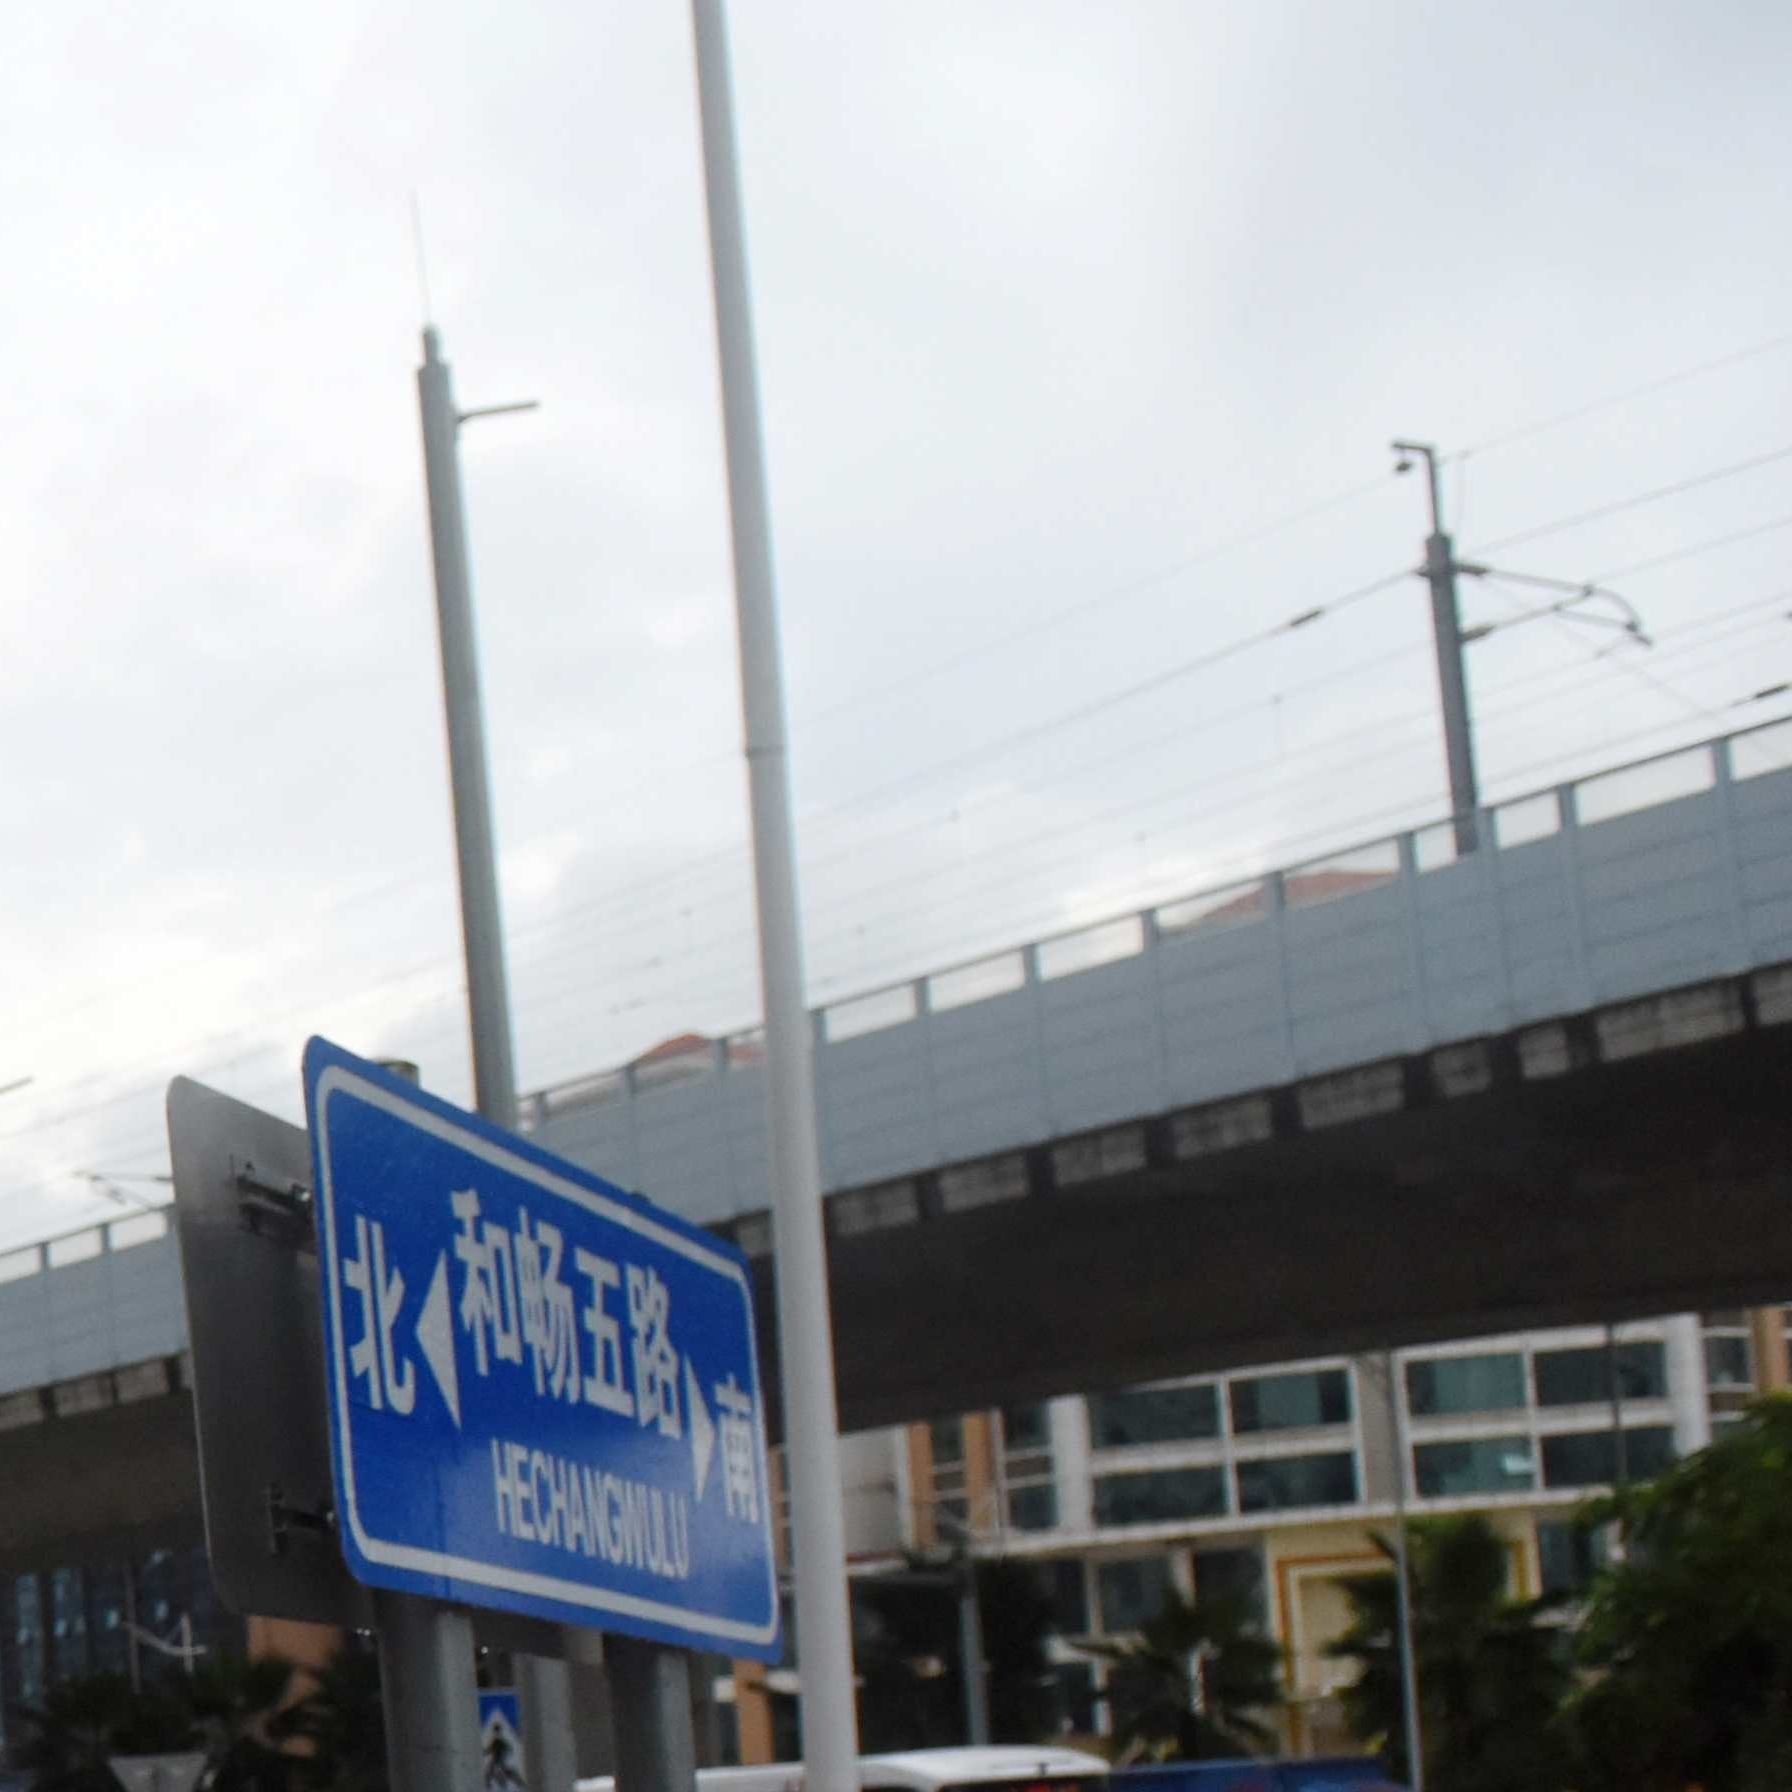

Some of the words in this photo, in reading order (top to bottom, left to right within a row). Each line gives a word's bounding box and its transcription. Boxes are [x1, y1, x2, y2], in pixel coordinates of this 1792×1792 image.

[344, 1214, 415, 1416] 北
[450, 1189, 682, 1441] 和畅五路
[714, 1372, 759, 1525] 南
